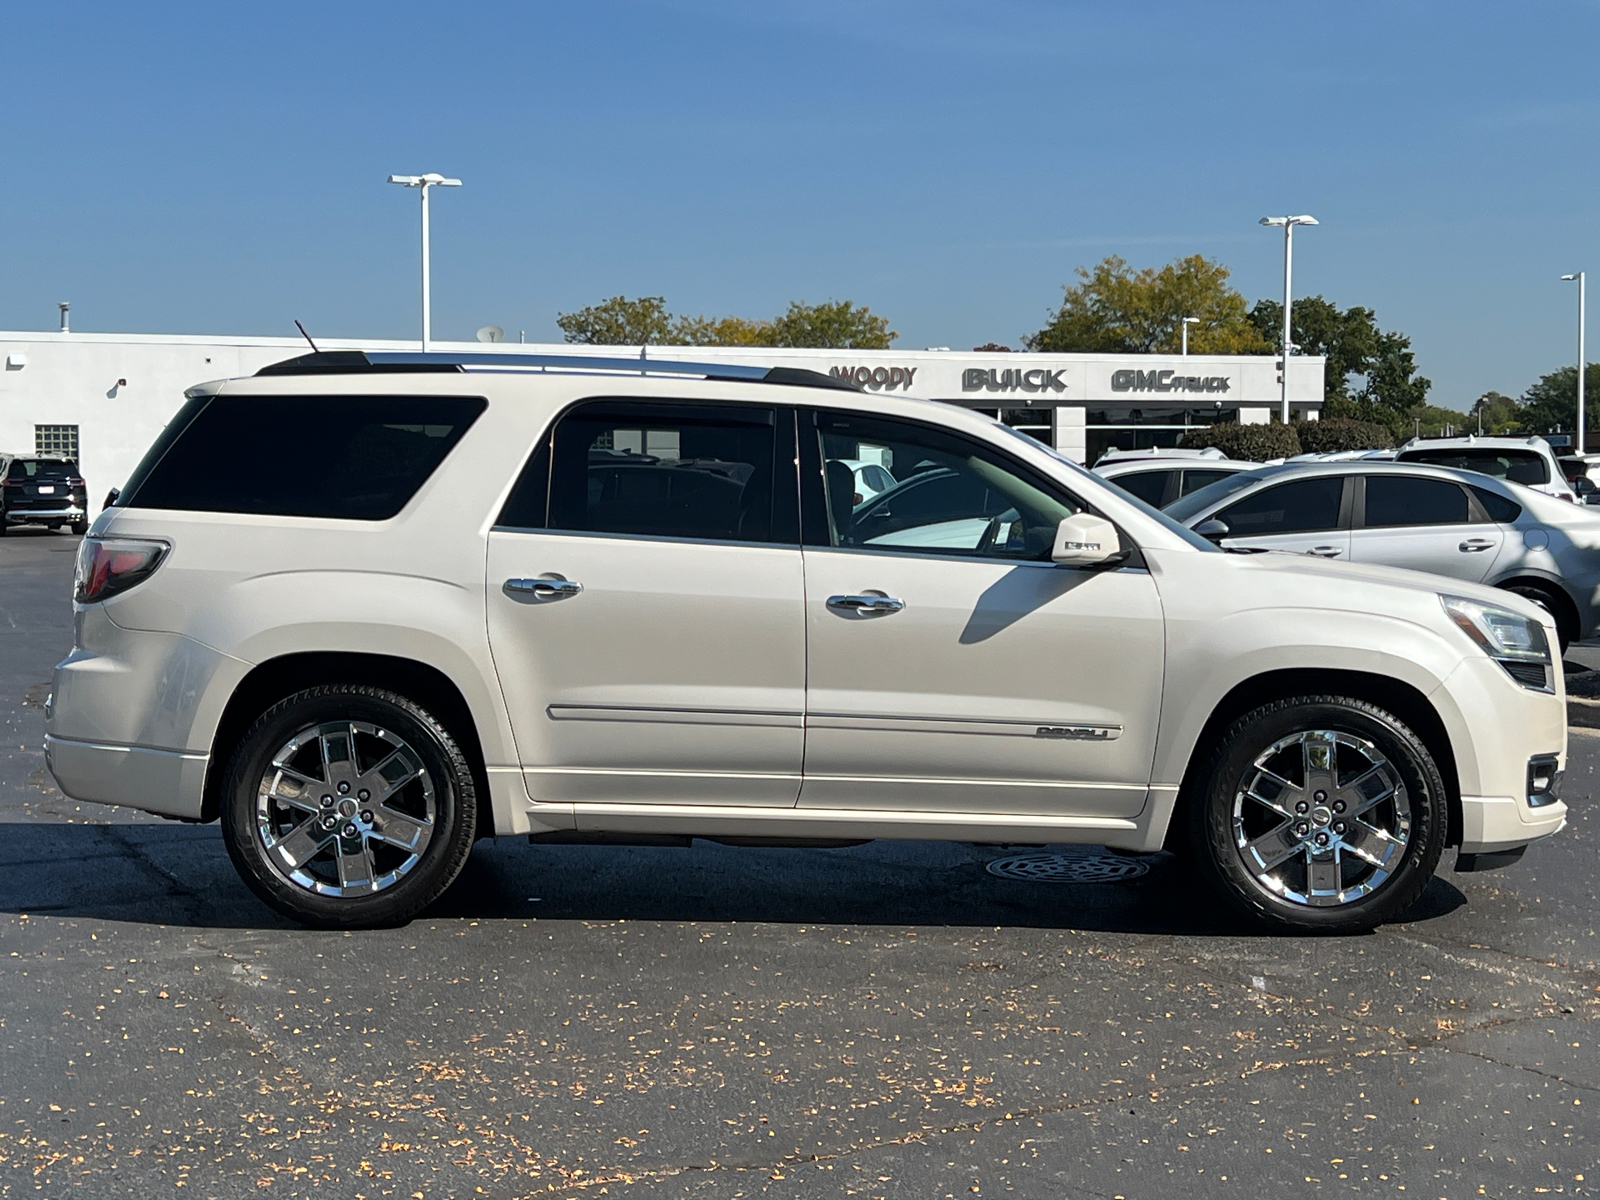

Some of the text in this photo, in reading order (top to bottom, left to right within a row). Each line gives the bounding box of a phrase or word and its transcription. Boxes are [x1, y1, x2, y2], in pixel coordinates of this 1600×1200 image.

[830, 366, 918, 390] WOODY
[962, 368, 1068, 391] BUICK
[1111, 369, 1231, 392] GMC TRUCK
